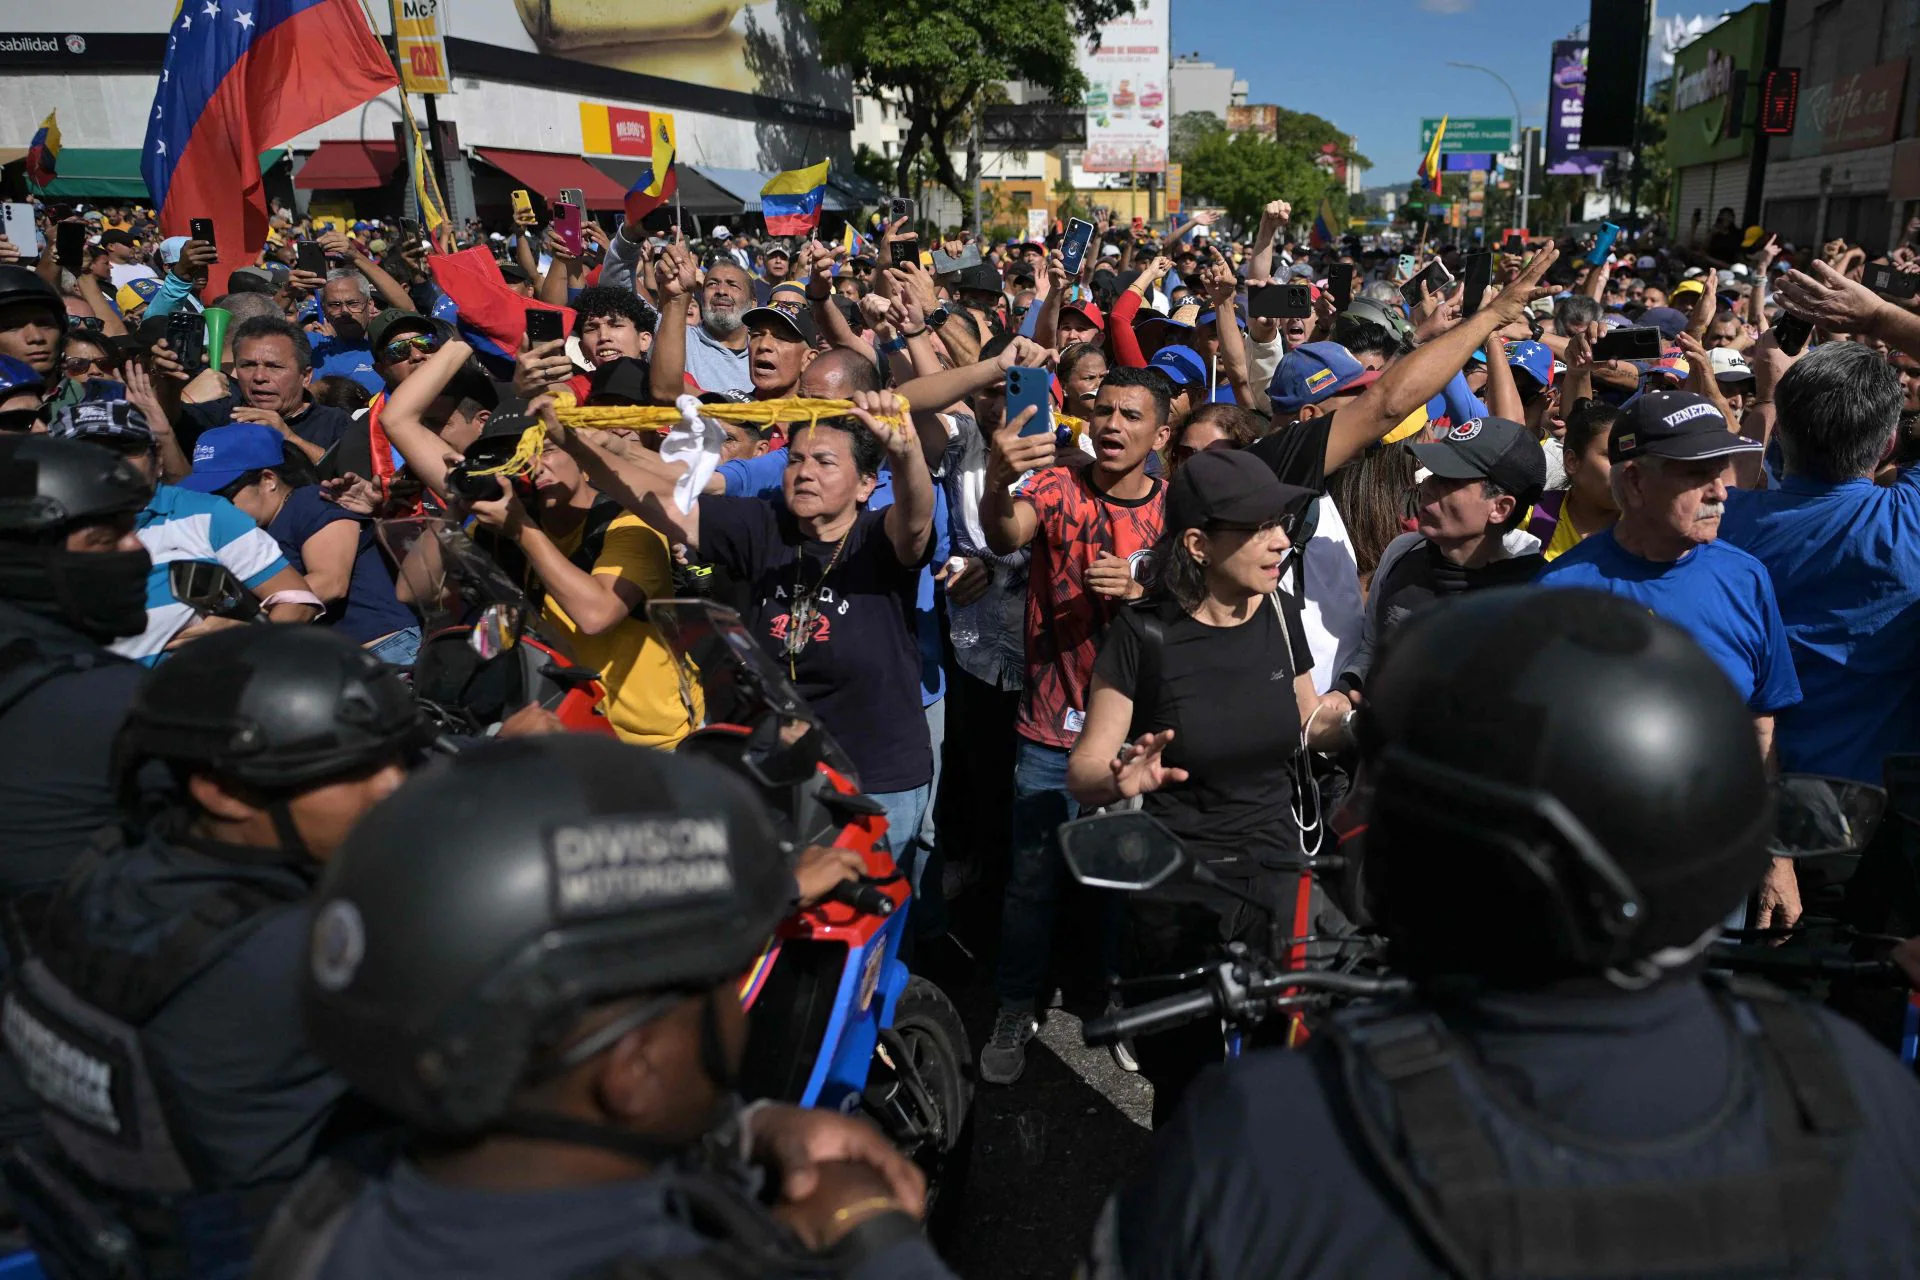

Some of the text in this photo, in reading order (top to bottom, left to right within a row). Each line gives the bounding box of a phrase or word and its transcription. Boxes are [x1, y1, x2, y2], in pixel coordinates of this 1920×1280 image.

[404, 0, 437, 17] Mc?
[0, 37, 59, 51] sabilidad
[555, 818, 730, 874] DIVISION
